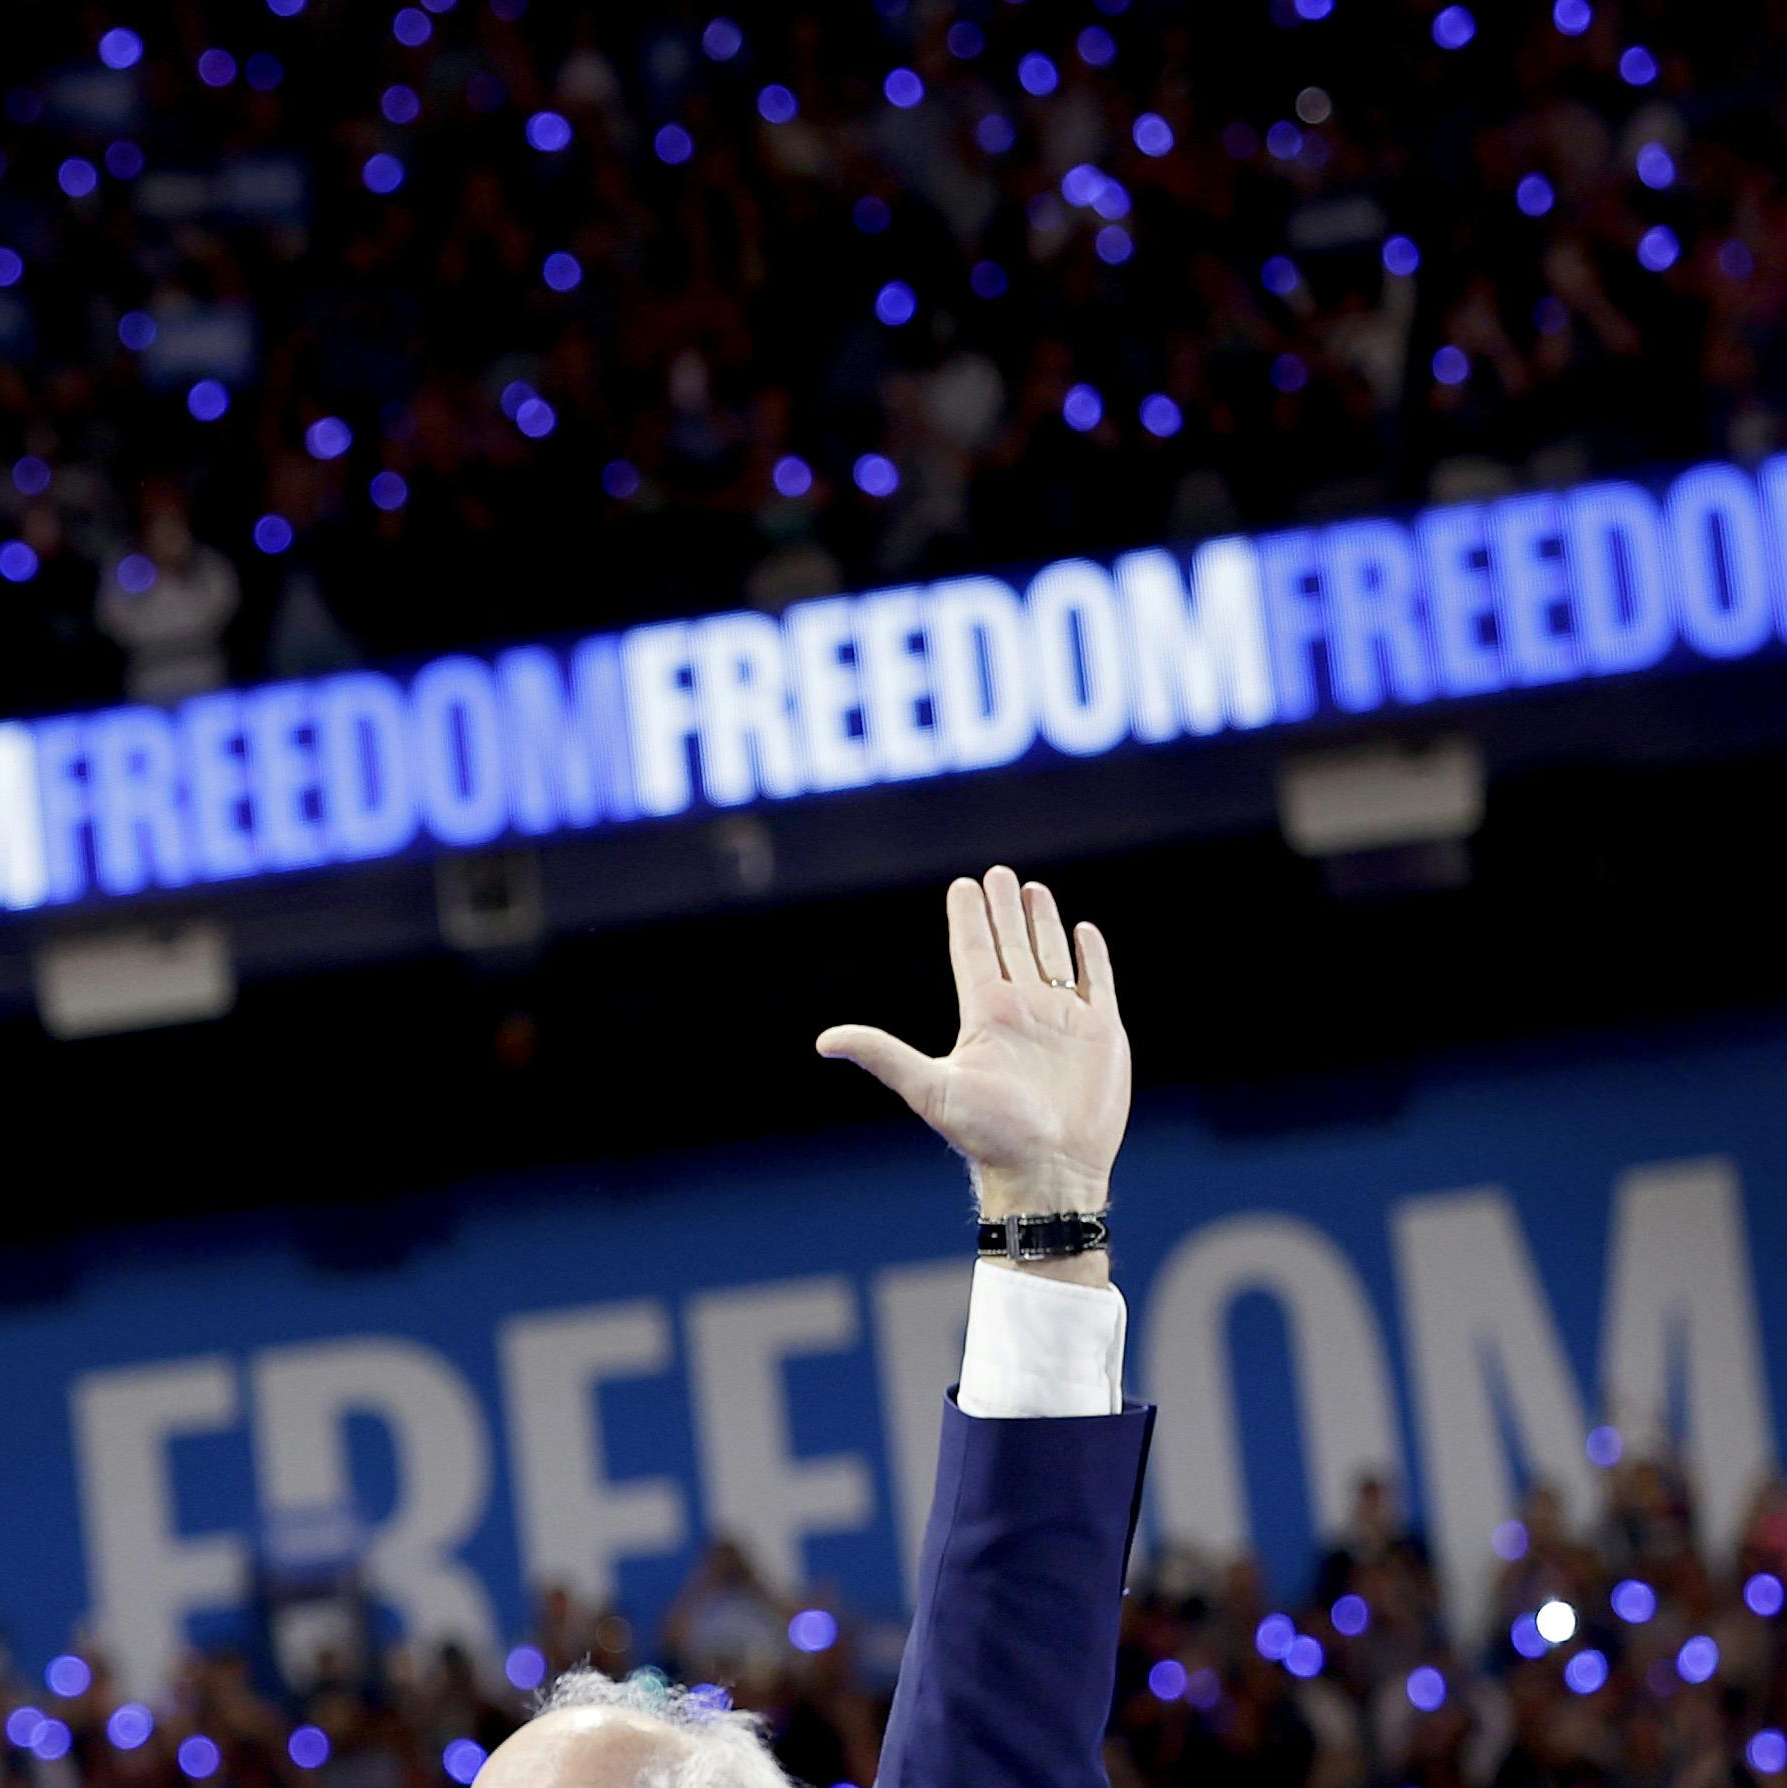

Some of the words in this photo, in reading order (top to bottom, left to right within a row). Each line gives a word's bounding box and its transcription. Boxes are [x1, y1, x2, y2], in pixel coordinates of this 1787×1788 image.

[37, 632, 633, 908] FREEDOM
[628, 535, 1277, 819] FREEDOM
[1257, 454, 1787, 724] FREEDO
